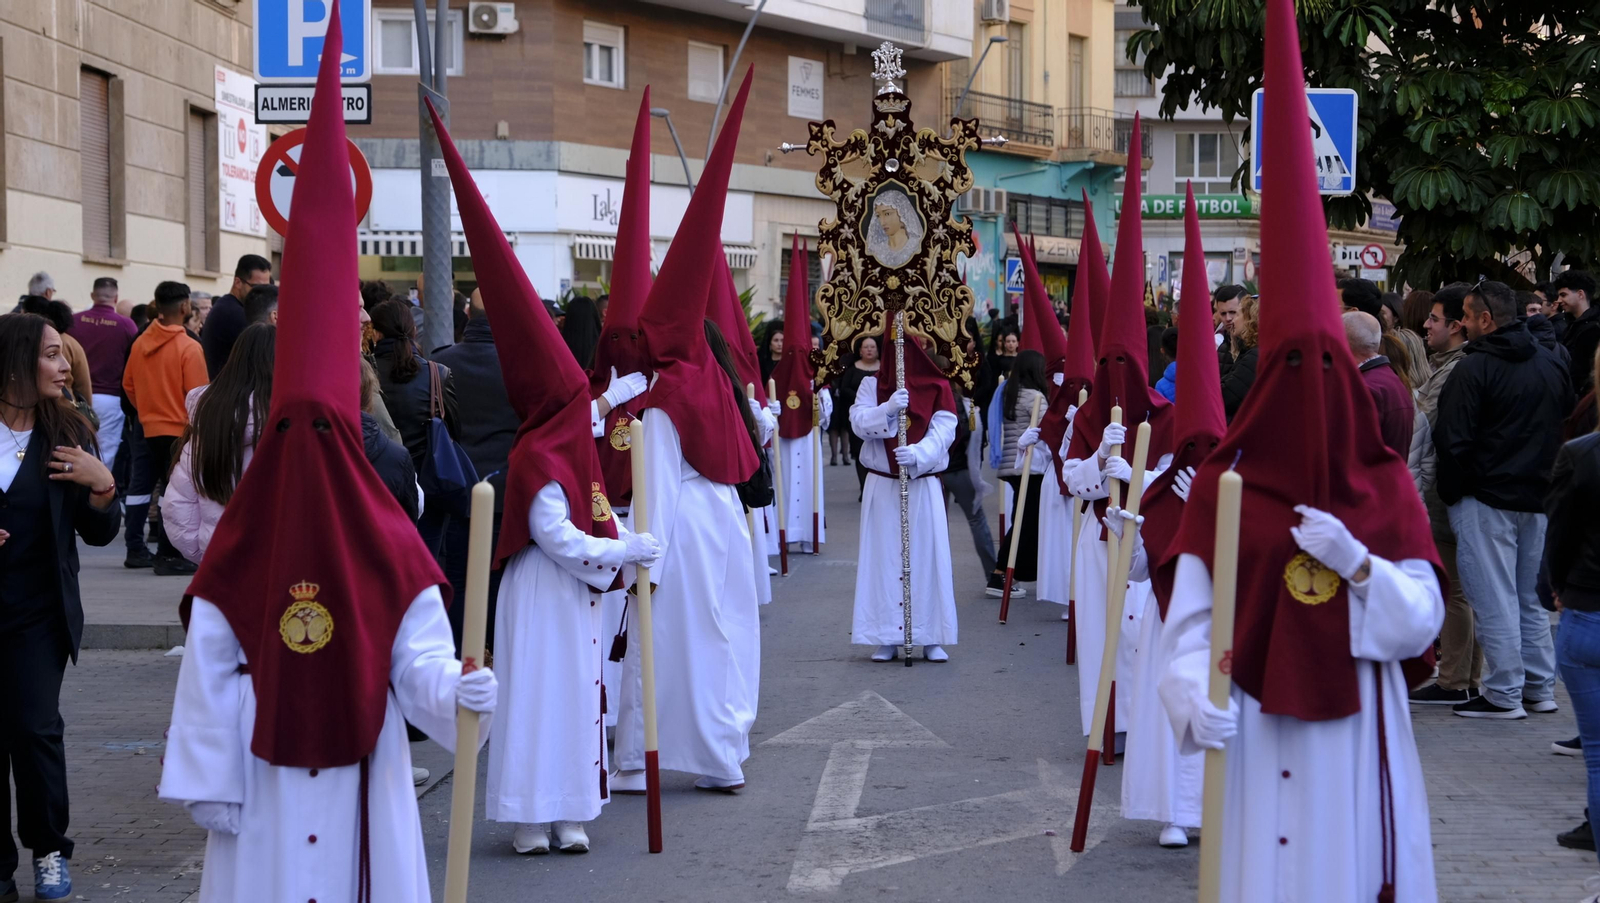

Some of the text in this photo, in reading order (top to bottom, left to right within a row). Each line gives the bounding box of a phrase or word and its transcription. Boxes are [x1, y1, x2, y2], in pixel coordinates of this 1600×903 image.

[792, 85, 820, 100] FEMMES
[591, 188, 618, 226] Lalá
[1153, 199, 1174, 214] DE
